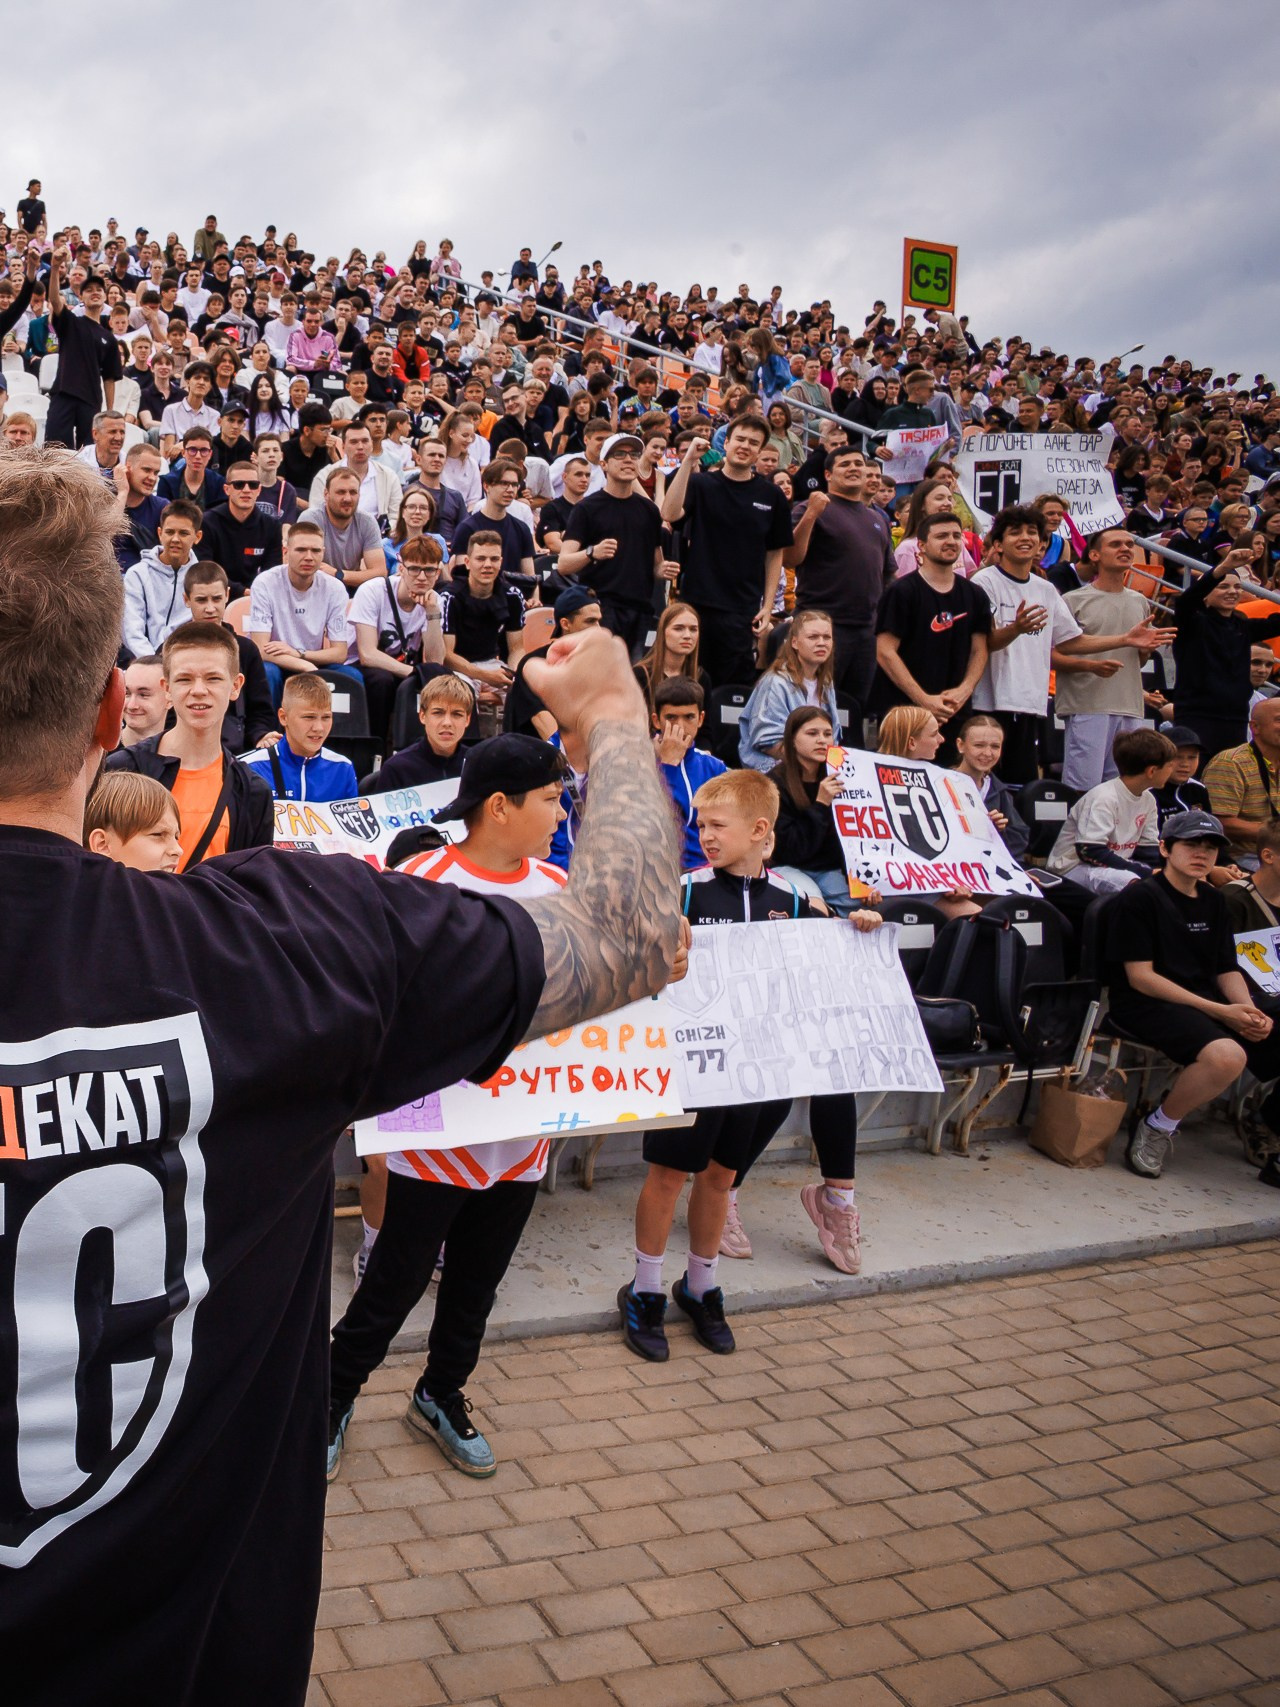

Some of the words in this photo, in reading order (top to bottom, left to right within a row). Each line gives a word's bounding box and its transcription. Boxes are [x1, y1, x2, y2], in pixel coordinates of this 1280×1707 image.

[913, 263, 948, 292] C5
[980, 434, 1033, 451] ПОМОЖЕТ
[1044, 434, 1071, 451] ДАЖЕ
[1079, 435, 1103, 452] ВАР
[1056, 479, 1087, 495] БУДЕТ
[1088, 479, 1103, 495] ЗА
[879, 766, 926, 786] СИНДЕКАТ
[385, 788, 422, 812] НА
[274, 803, 332, 836] РАЛ
[835, 804, 892, 840] ЕКБ
[884, 785, 939, 852] FC
[885, 861, 994, 892] СИНДЕКАТ
[726, 964, 904, 1019] ПЛАКАТ
[675, 1025, 726, 1044] CHIZH
[686, 1048, 726, 1075] 77
[735, 1055, 796, 1100] ОТ
